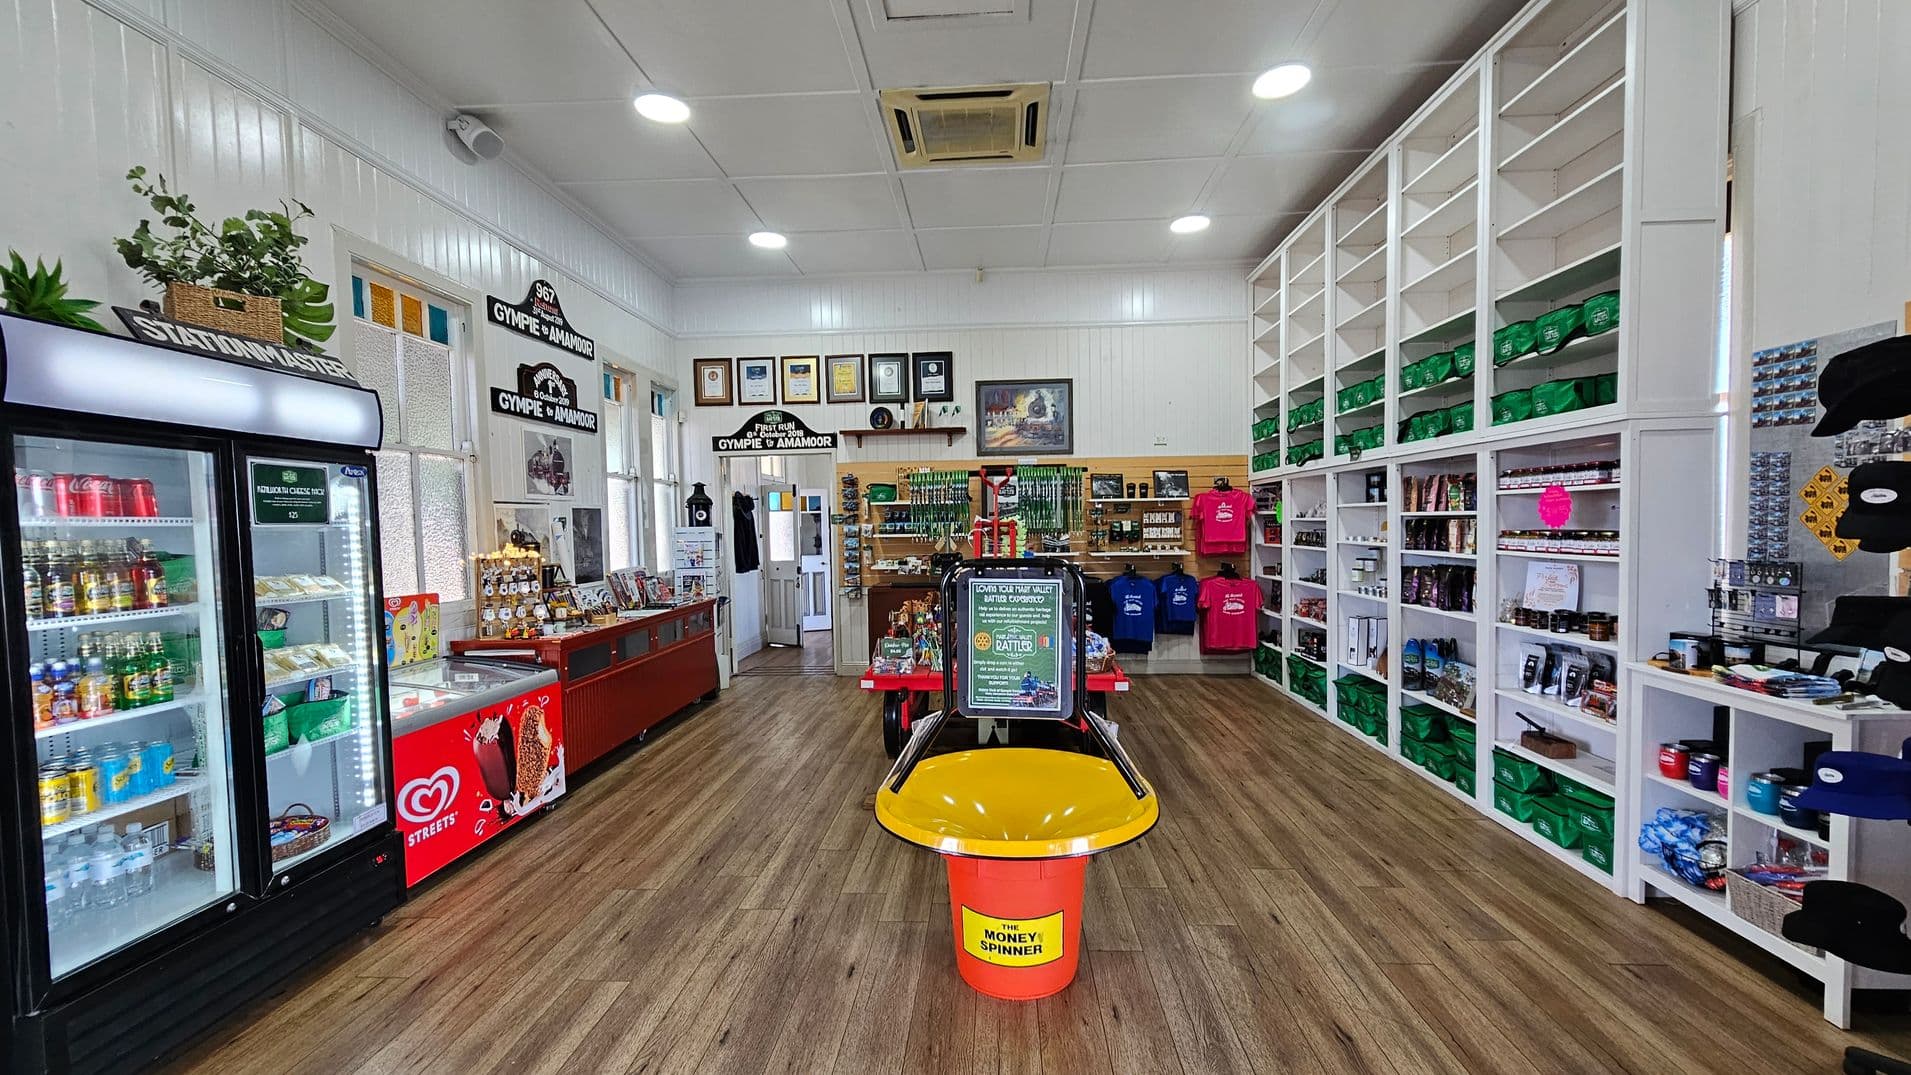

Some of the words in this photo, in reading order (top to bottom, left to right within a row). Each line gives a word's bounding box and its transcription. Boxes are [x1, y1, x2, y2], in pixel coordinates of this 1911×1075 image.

[536, 282, 554, 303] 967
[493, 302, 540, 336] GYMPIE
[541, 324, 549, 335] to
[549, 325, 593, 357] AMAMOOR
[132, 315, 356, 381] STATIONMASTER
[539, 391, 559, 404] October
[498, 392, 543, 418] GYMPIE
[546, 405, 553, 416] to
[554, 406, 596, 430] AMAMOOR
[755, 423, 776, 432] FIRST
[778, 421, 795, 431] RUN
[760, 430, 786, 438] October
[718, 438, 762, 450] GYMPIE
[766, 439, 774, 448] to
[776, 436, 832, 448] AMAMOOR
[289, 487, 311, 496] CHEESE
[976, 585, 997, 593] LOVING
[998, 585, 1014, 593] YOUR
[1015, 585, 1031, 593] MARY
[1032, 586, 1053, 594] VALLEY
[984, 595, 1007, 603] RATTLER
[995, 640, 1033, 652] RATTLER
[408, 813, 456, 847] STREETS
[1001, 923, 1019, 931] THE
[984, 929, 1037, 943] MONEY
[979, 940, 1043, 956] SPINNER
